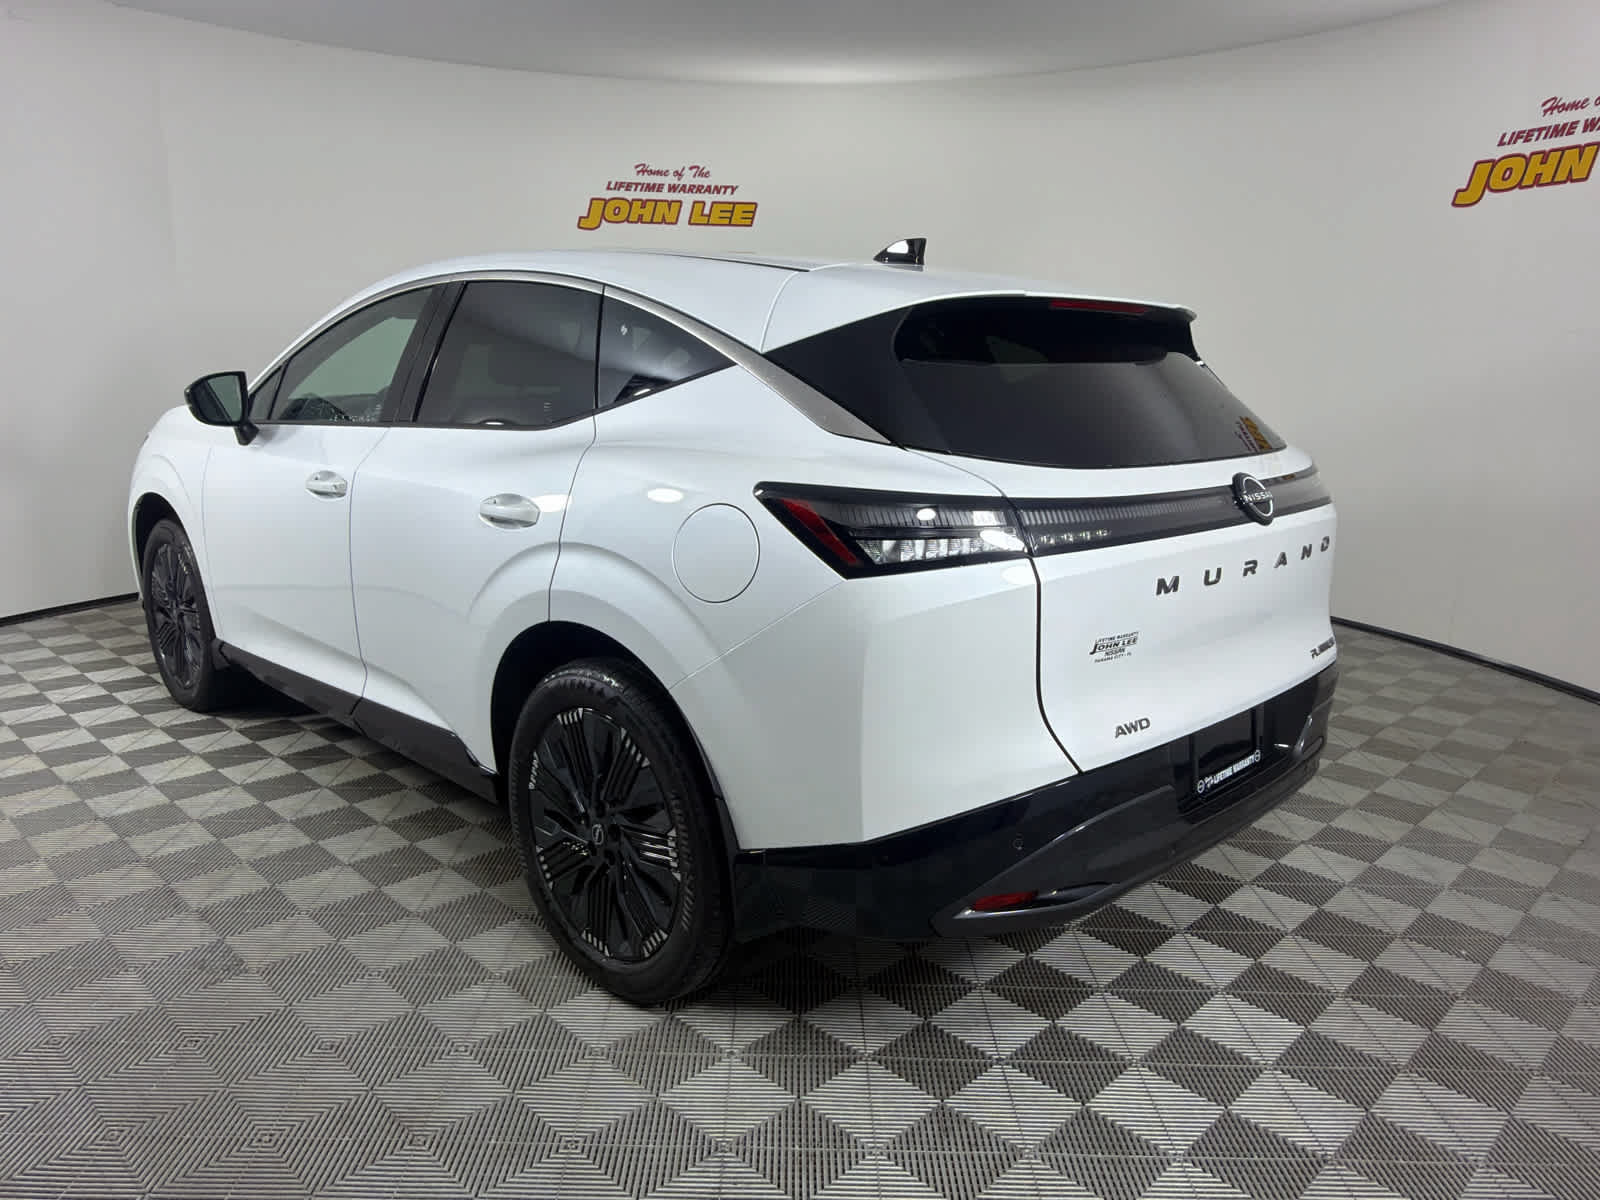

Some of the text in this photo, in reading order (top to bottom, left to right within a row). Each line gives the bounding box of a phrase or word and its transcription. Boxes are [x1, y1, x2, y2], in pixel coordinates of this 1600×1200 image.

[1541, 96, 1590, 118] Home
[1497, 120, 1580, 147] LIFETIME
[634, 163, 711, 181] Home of The
[1451, 141, 1600, 208] JOHN
[606, 181, 739, 196] LIFETIME WARRANTY
[577, 197, 758, 231] JOHN LEE
[1241, 489, 1274, 505] NISSAN
[1155, 535, 1331, 597] MURANO
[1089, 636, 1138, 655] JOHN LEE
[1114, 717, 1151, 739] AWD
